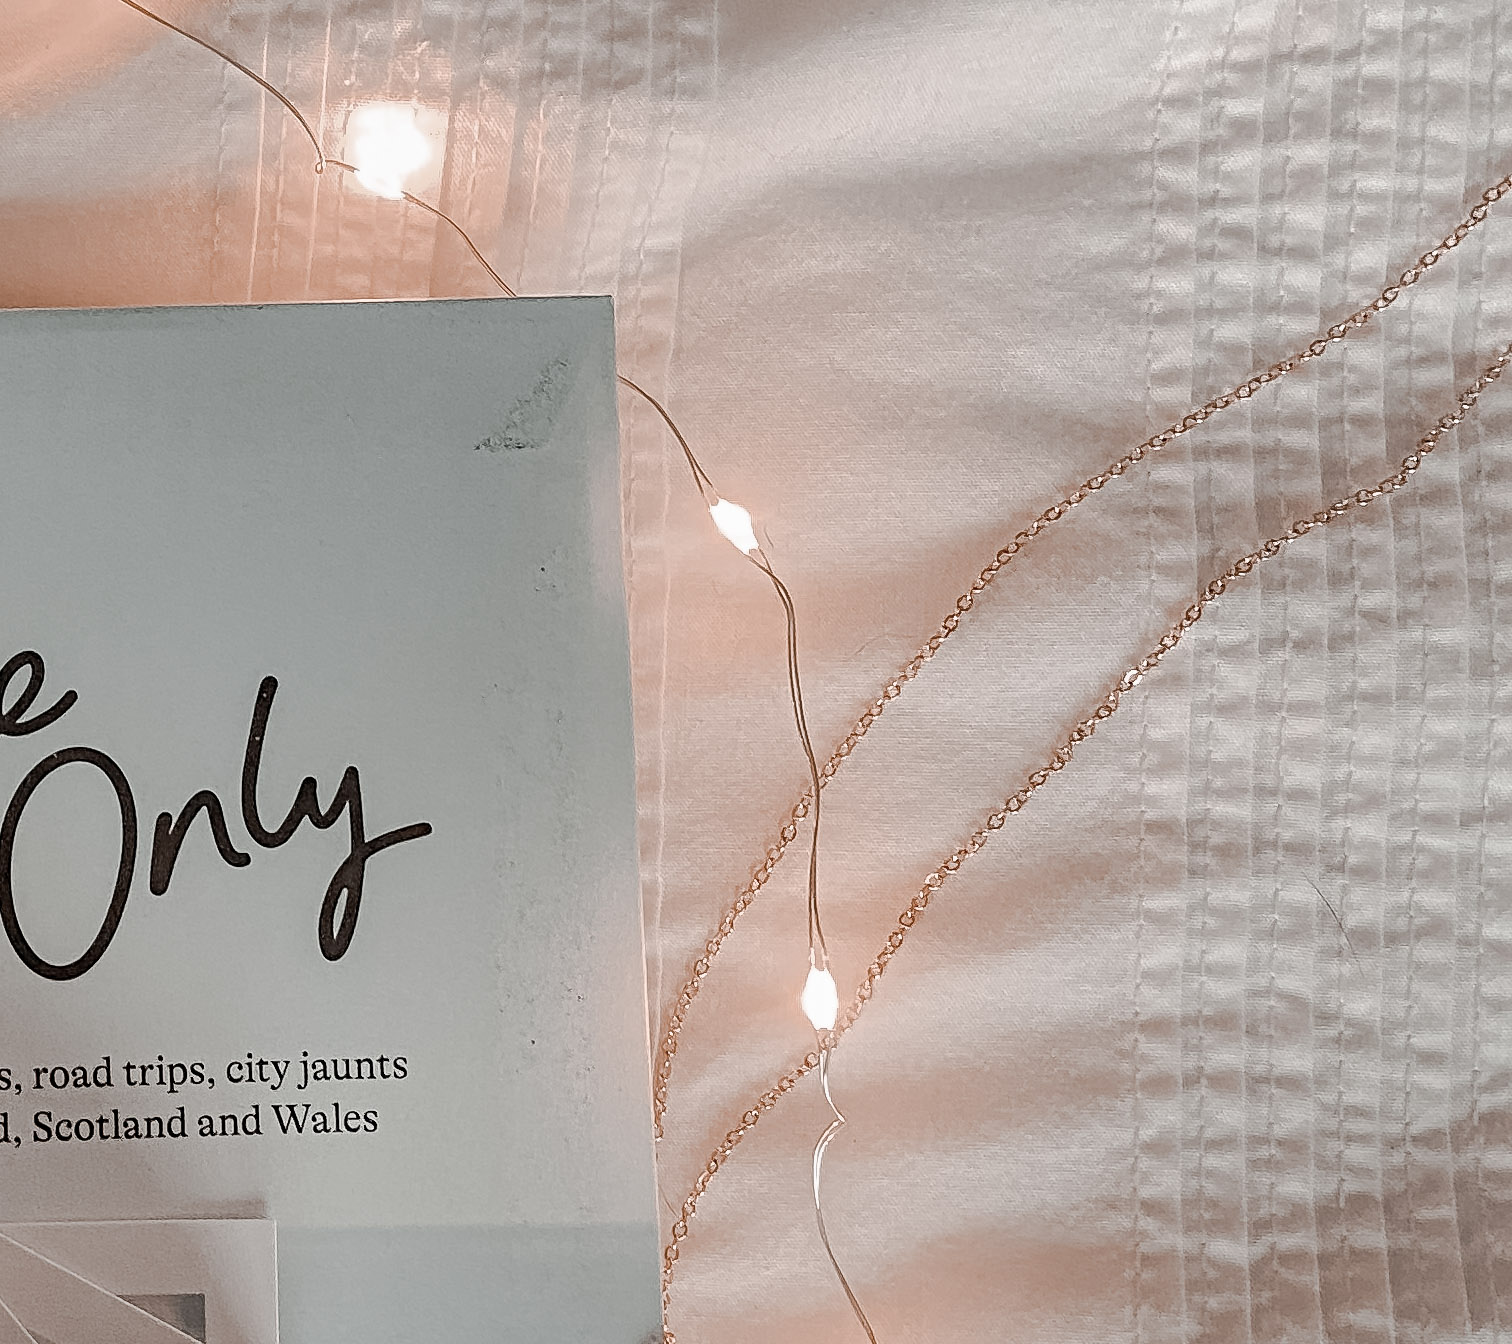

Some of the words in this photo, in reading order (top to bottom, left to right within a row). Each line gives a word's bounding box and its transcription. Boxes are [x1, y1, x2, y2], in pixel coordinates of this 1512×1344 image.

[32, 1055, 115, 1090] road
[122, 1054, 216, 1095] trips,
[226, 1052, 291, 1091] city
[296, 1050, 408, 1090] jaunts
[33, 1106, 189, 1143] Scotland
[197, 1104, 264, 1138] and
[271, 1102, 378, 1135] Wales
